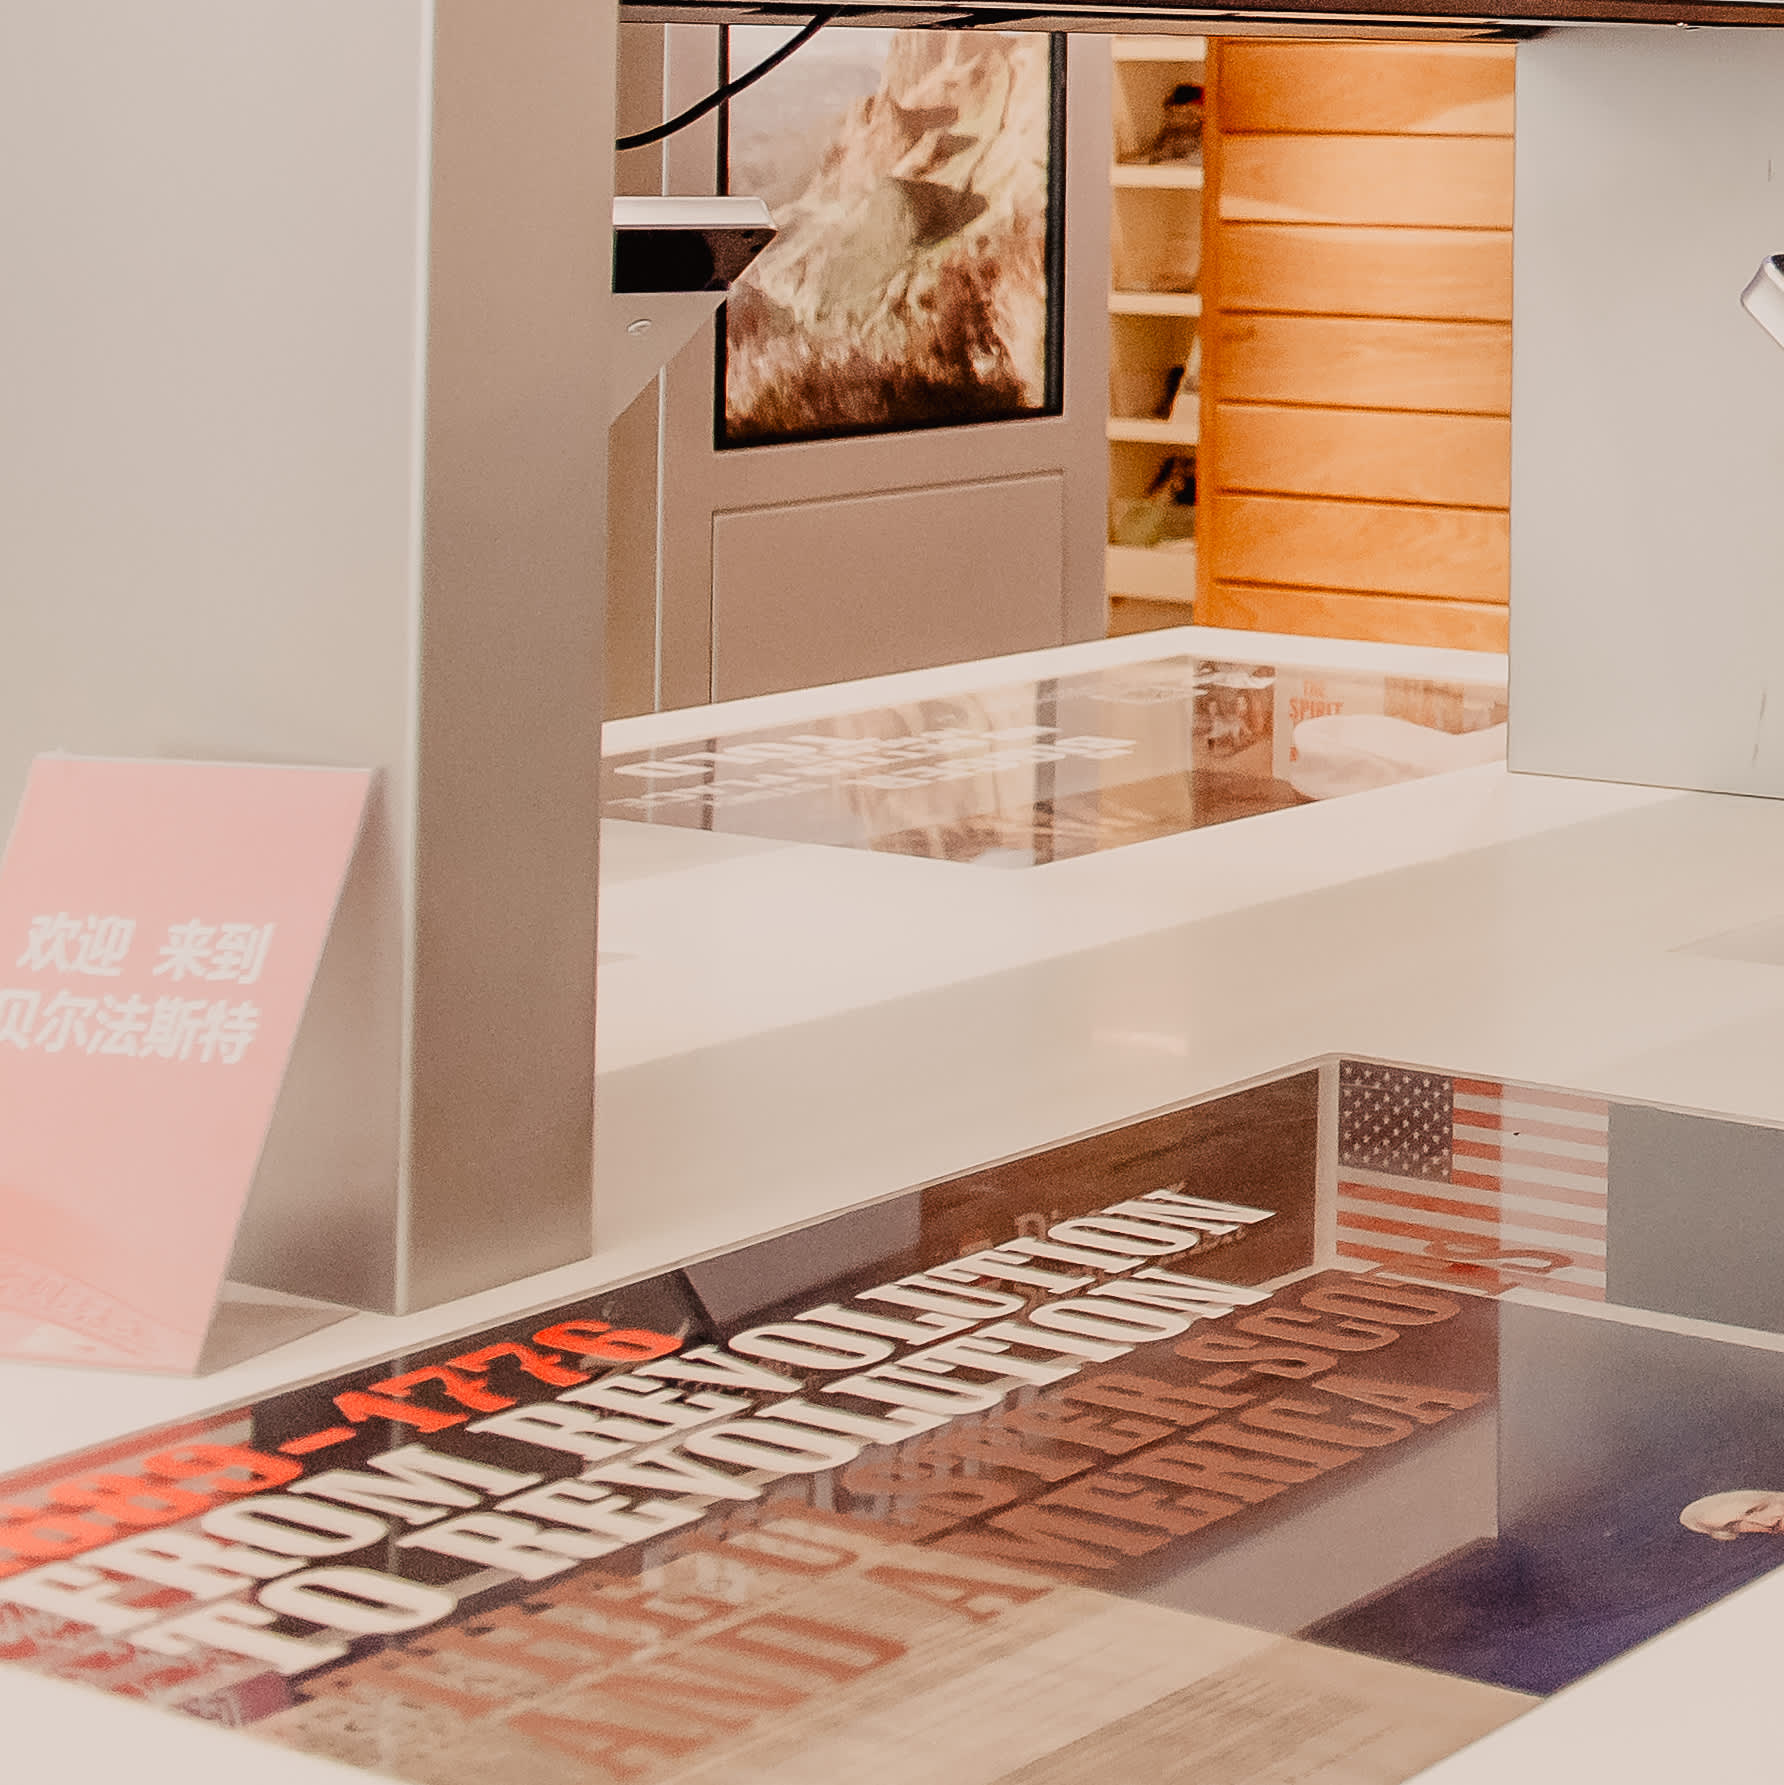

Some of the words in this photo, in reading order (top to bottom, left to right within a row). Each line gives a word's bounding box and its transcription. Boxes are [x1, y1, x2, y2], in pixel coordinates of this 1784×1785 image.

[0, 988, 261, 1065] 贝尔法斯特
[15, 911, 137, 977] 欢迎
[151, 918, 279, 985] 来到
[0, 1443, 537, 1637] FROM
[466, 1190, 1278, 1462] REVOLUTION
[0, 1319, 685, 1578] 689-1776
[127, 1565, 460, 1676] TO
[397, 1267, 1276, 1582] REVOLUTION
[503, 1610, 910, 1783] AND
[860, 1372, 1497, 1623] AMERICA
